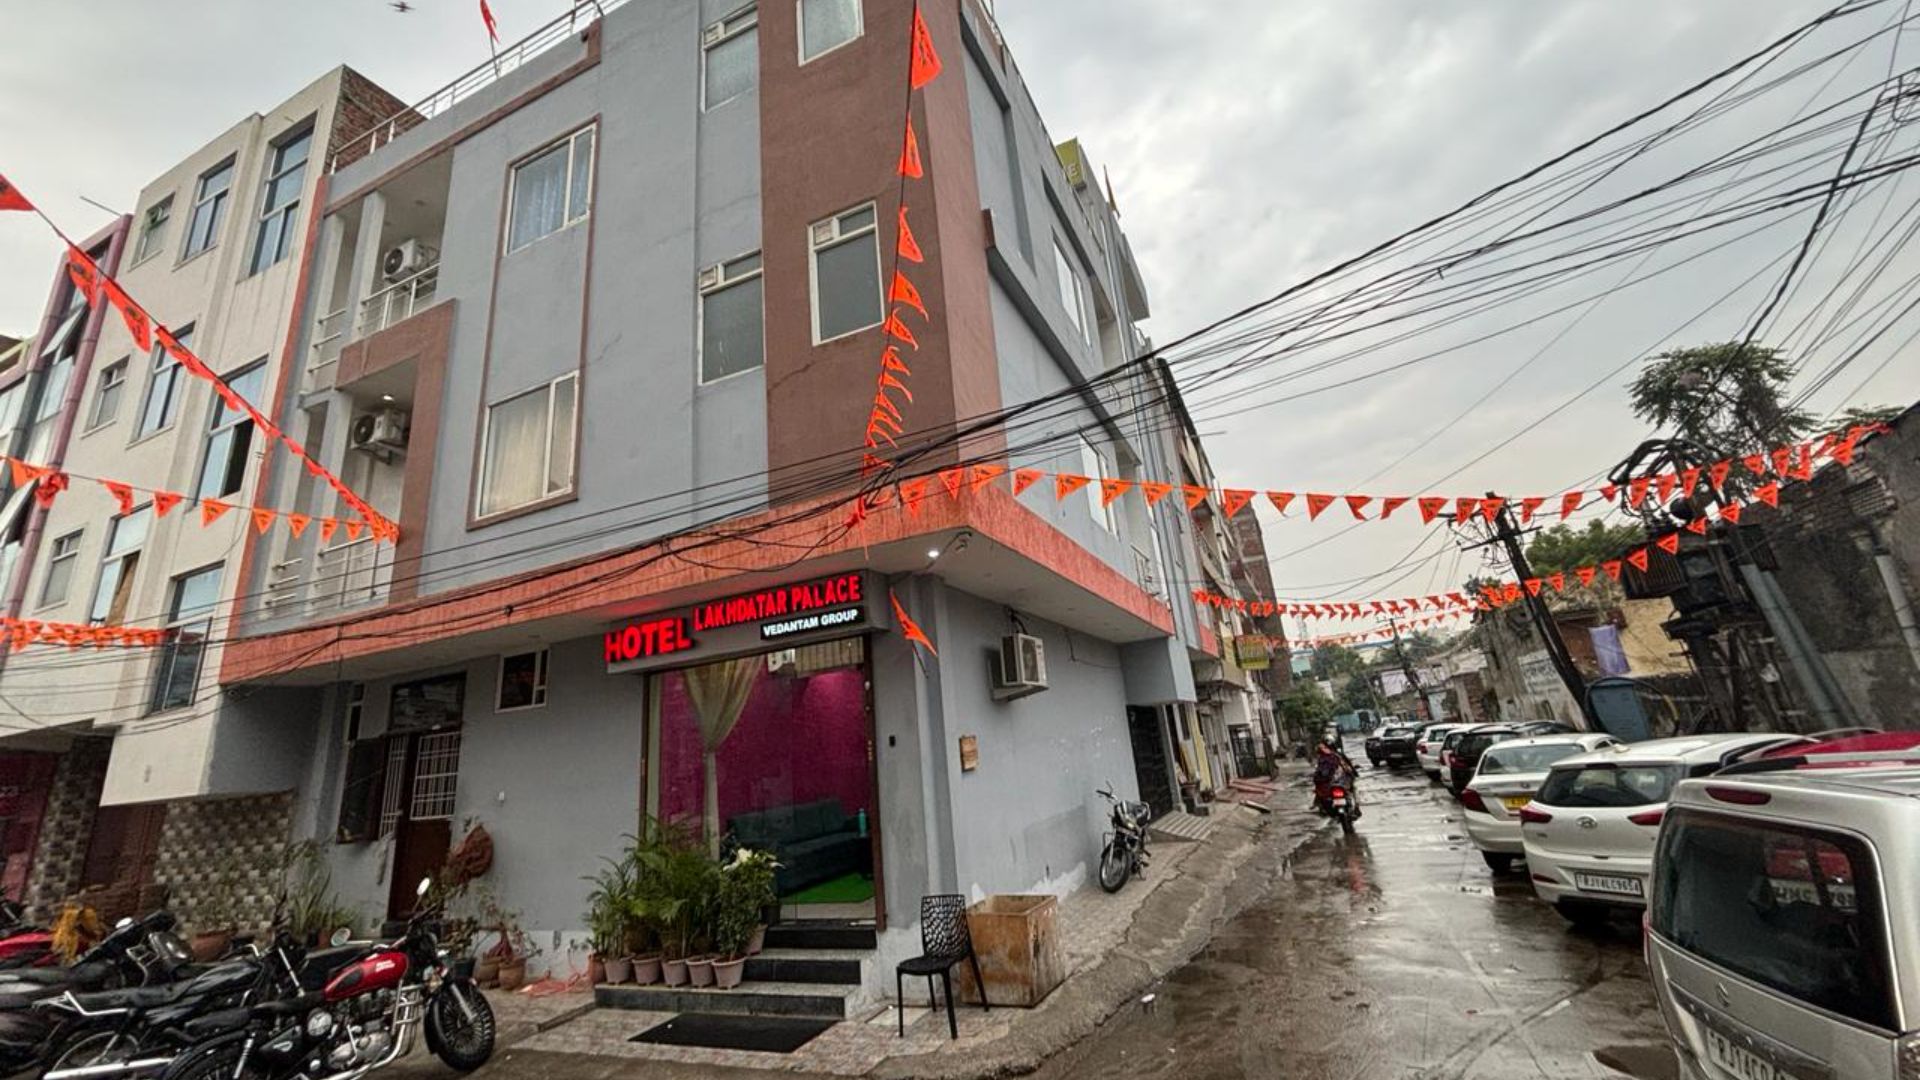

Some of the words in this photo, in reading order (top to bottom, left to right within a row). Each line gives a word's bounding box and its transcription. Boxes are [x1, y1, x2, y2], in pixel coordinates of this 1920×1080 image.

[604, 617, 692, 662] HOTEL
[693, 589, 787, 632] LAKHDATAR
[791, 575, 861, 612] PALACE
[763, 616, 819, 637] VEDANTAM
[821, 608, 858, 626] GROUP
